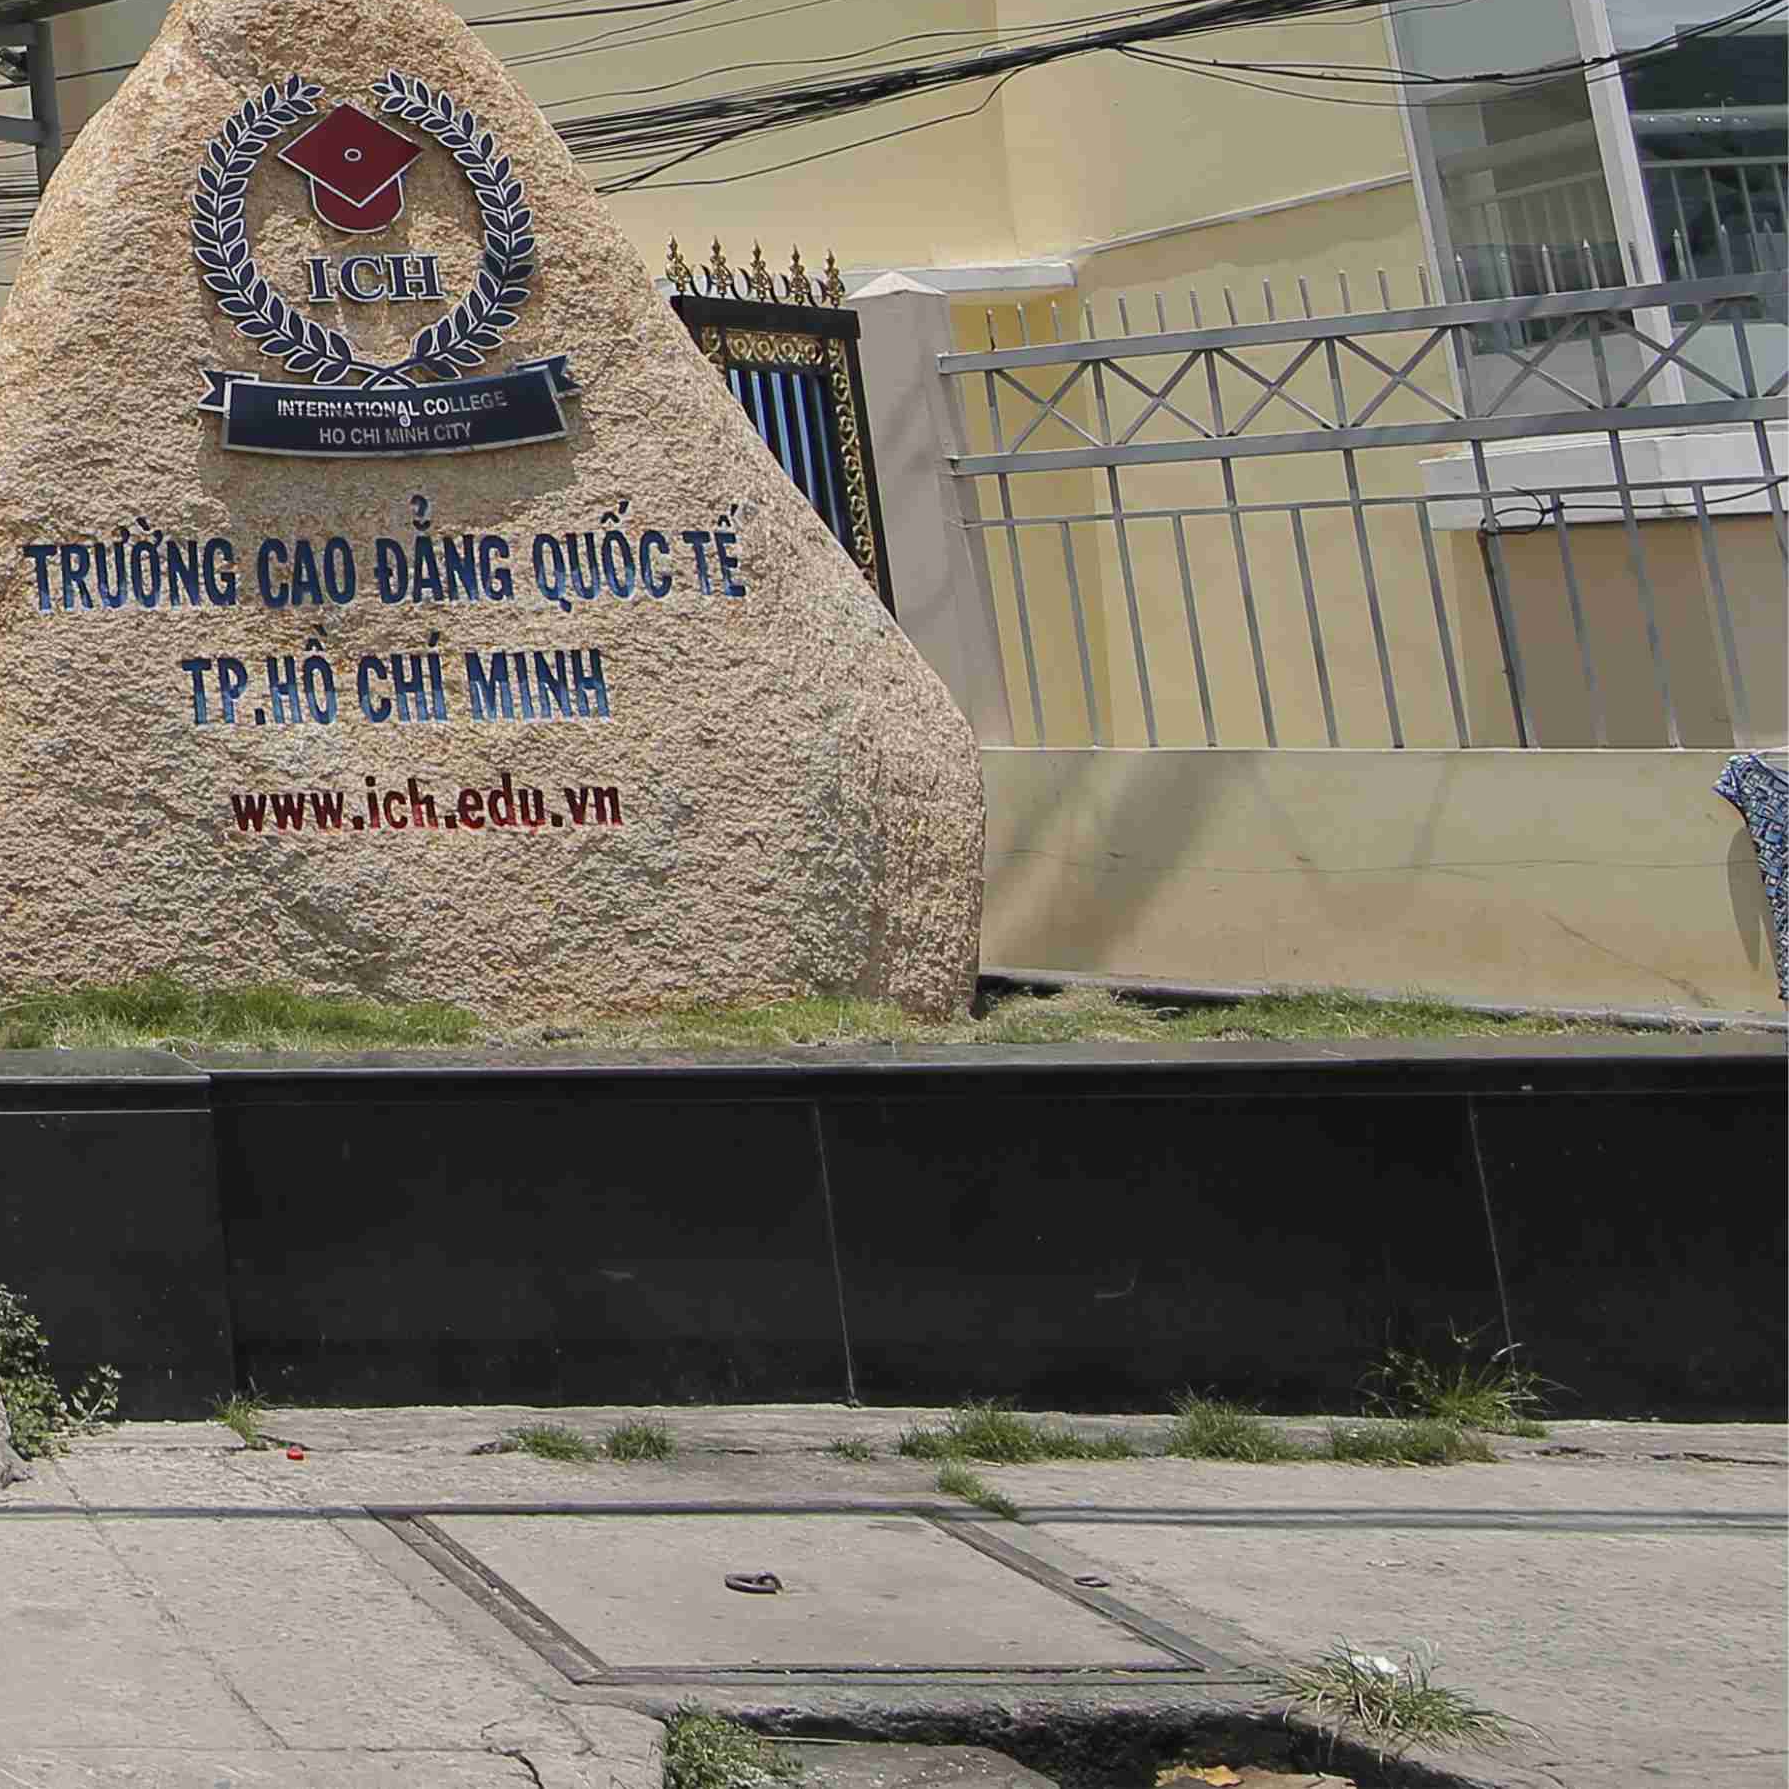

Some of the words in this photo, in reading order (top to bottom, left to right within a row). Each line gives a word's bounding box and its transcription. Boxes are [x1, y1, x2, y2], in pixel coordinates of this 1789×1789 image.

[306, 251, 444, 304] ICH
[276, 397, 420, 419] INTERNATIONAL
[423, 390, 509, 416] COLLEGE
[319, 427, 346, 445] HO
[350, 426, 381, 445] CHI
[385, 424, 430, 445] MINH
[433, 421, 472, 442] CITY
[21, 515, 237, 614] TRƯỜNG
[256, 535, 357, 609] CAO
[374, 494, 515, 605] ĐẲNG
[532, 499, 672, 612] QUỐC
[681, 503, 747, 598] TẾ
[357, 629, 449, 723] CHÍ
[464, 646, 613, 723] MINH
[230, 771, 623, 833] www.ich.edu.vn
